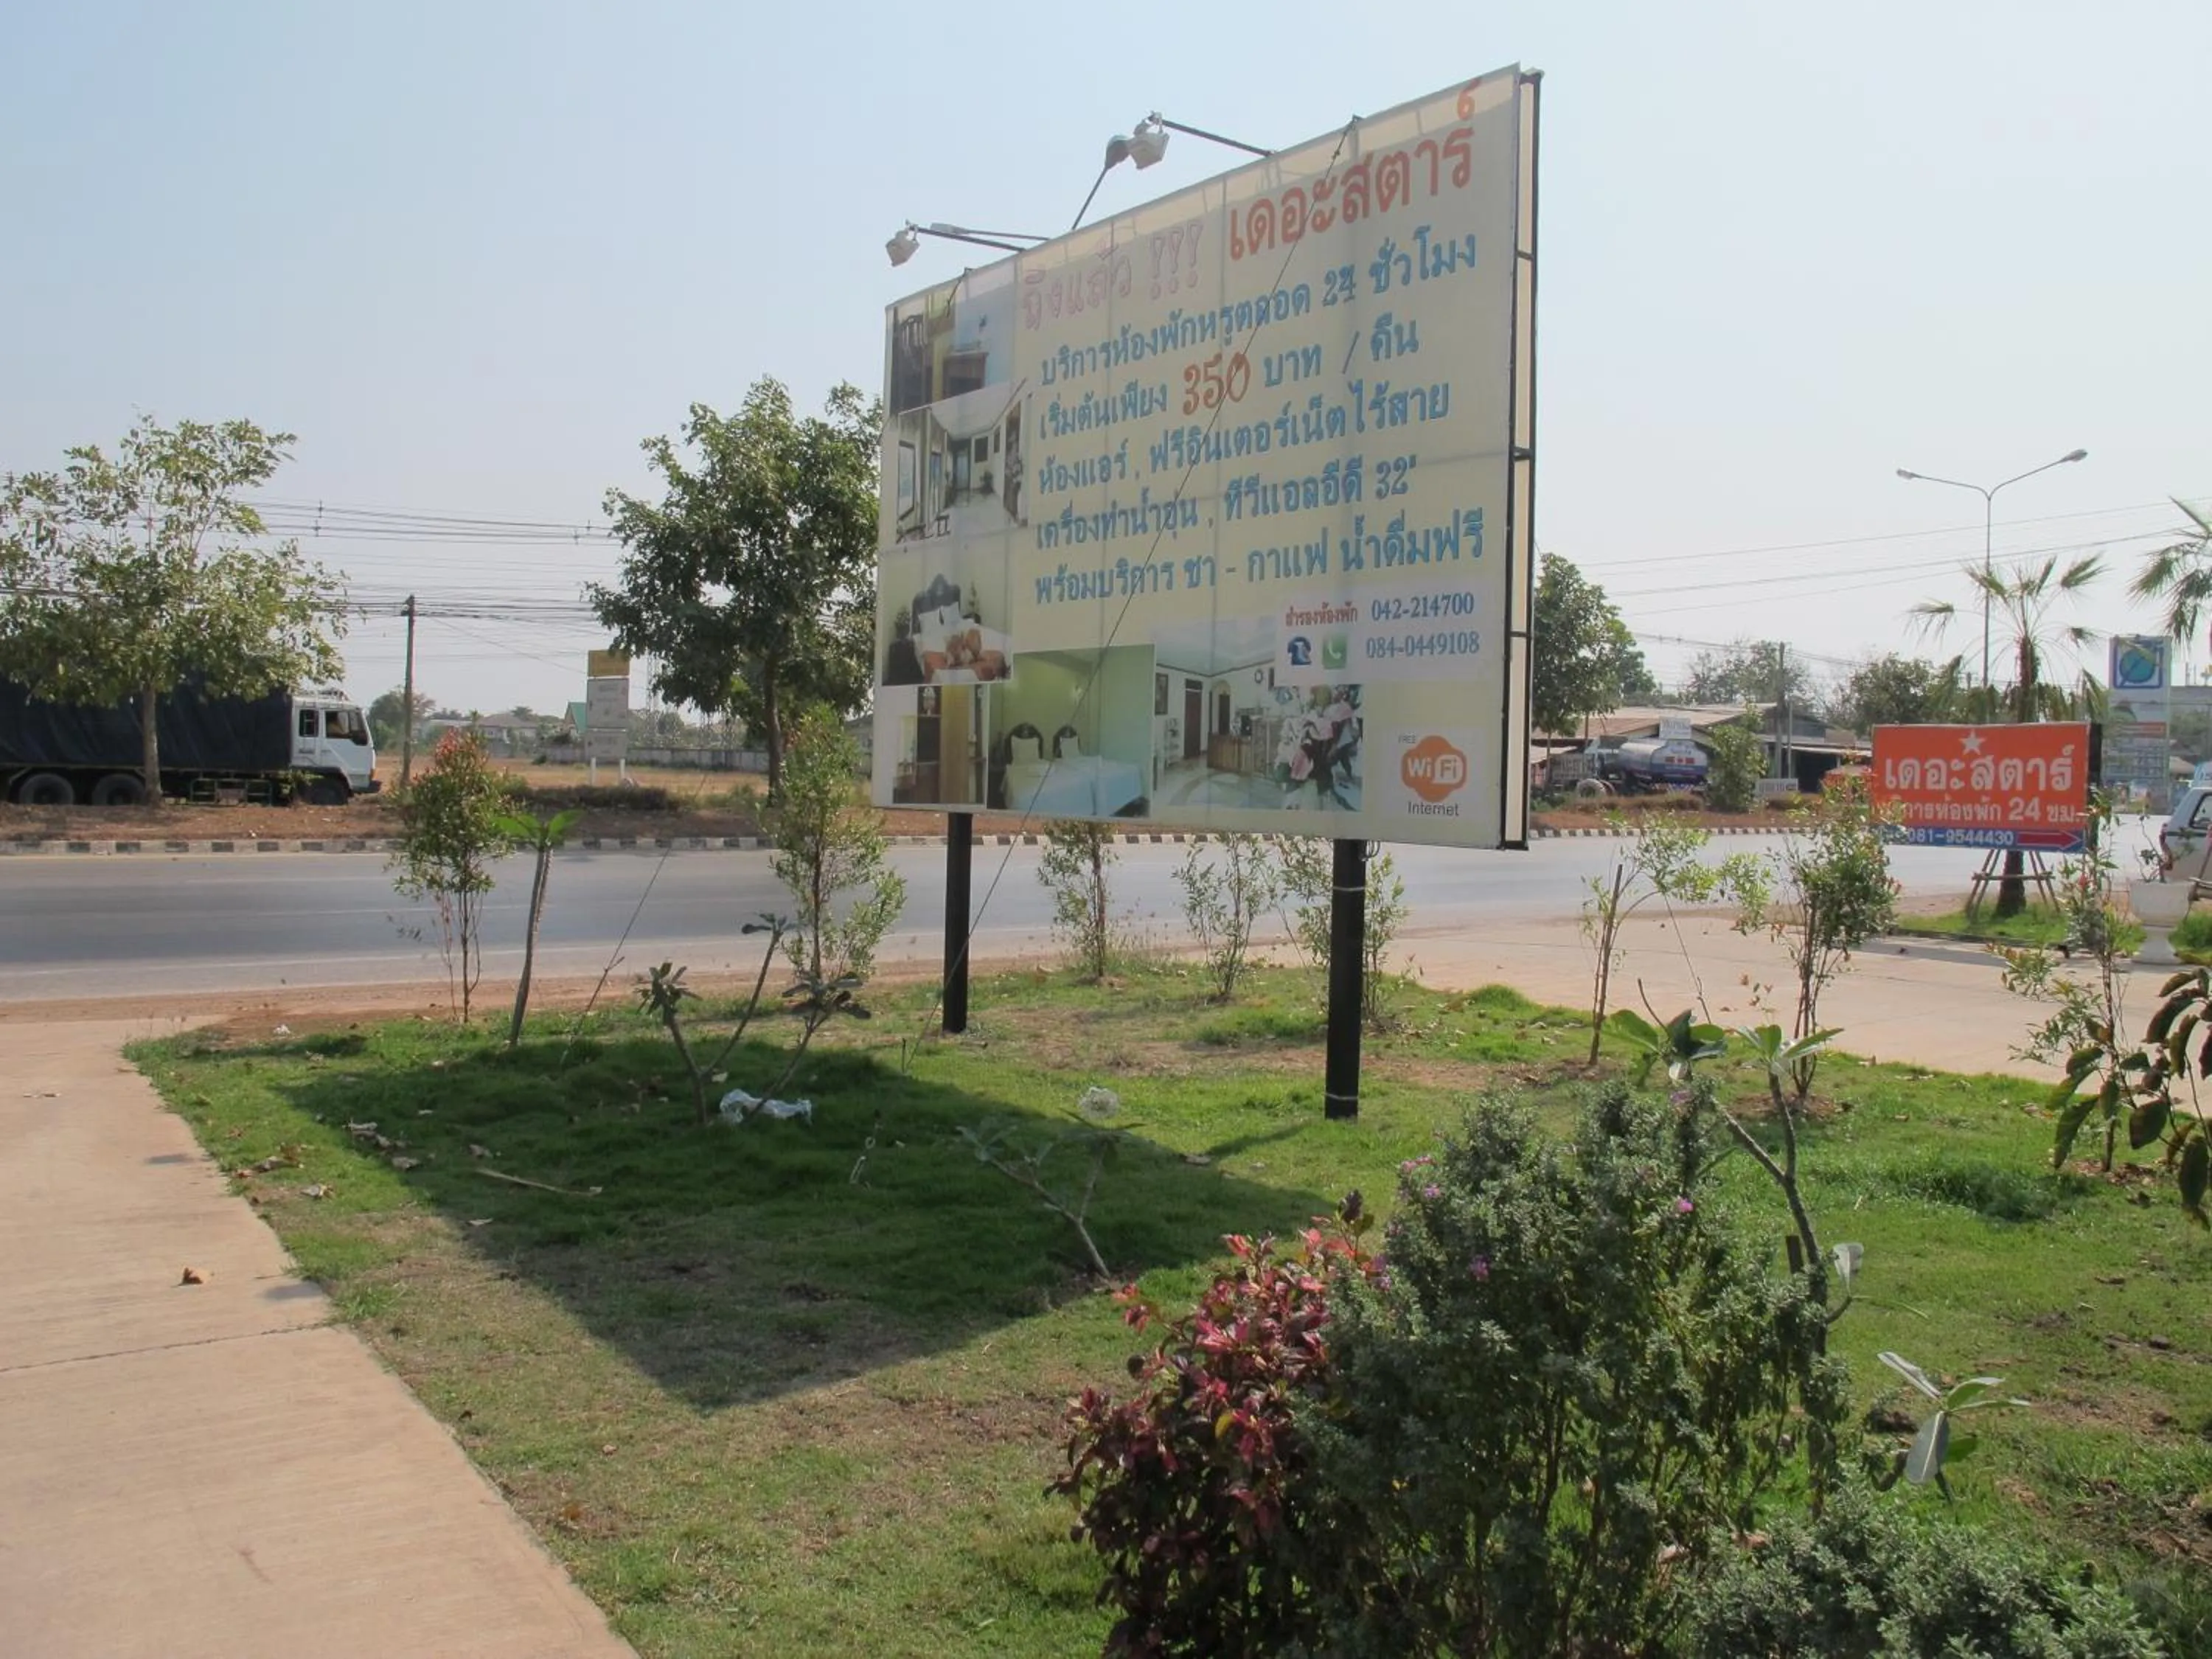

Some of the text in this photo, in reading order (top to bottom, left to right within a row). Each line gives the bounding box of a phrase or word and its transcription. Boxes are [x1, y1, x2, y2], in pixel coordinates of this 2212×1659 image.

[1231, 78, 1480, 260] เดอะสตาร์
[1041, 225, 1475, 386] บริการห้องพักหรูตลอด 24 ชั่วโมง
[1040, 379, 1168, 439] เริ่มต้นเพียง
[1183, 351, 1251, 416] 350
[1263, 344, 1322, 387] บาท
[1370, 312, 1419, 361] คืน
[1039, 438, 1129, 494] ห้องแอร์
[1036, 557, 1175, 605] พร้อมบริการ
[1183, 555, 1216, 588] ชา
[1248, 526, 1329, 582] กาแฟ
[1340, 507, 1484, 572] น้ำดื่มฟรี
[1371, 592, 1474, 621] 042-214700
[1366, 631, 1481, 658] 084-0449108
[1885, 744, 2076, 792] เดอะสตาร์
[1407, 801, 1459, 816] Internet
[2008, 796, 2040, 822] 24
[1907, 827, 2014, 846] 081-9544430
